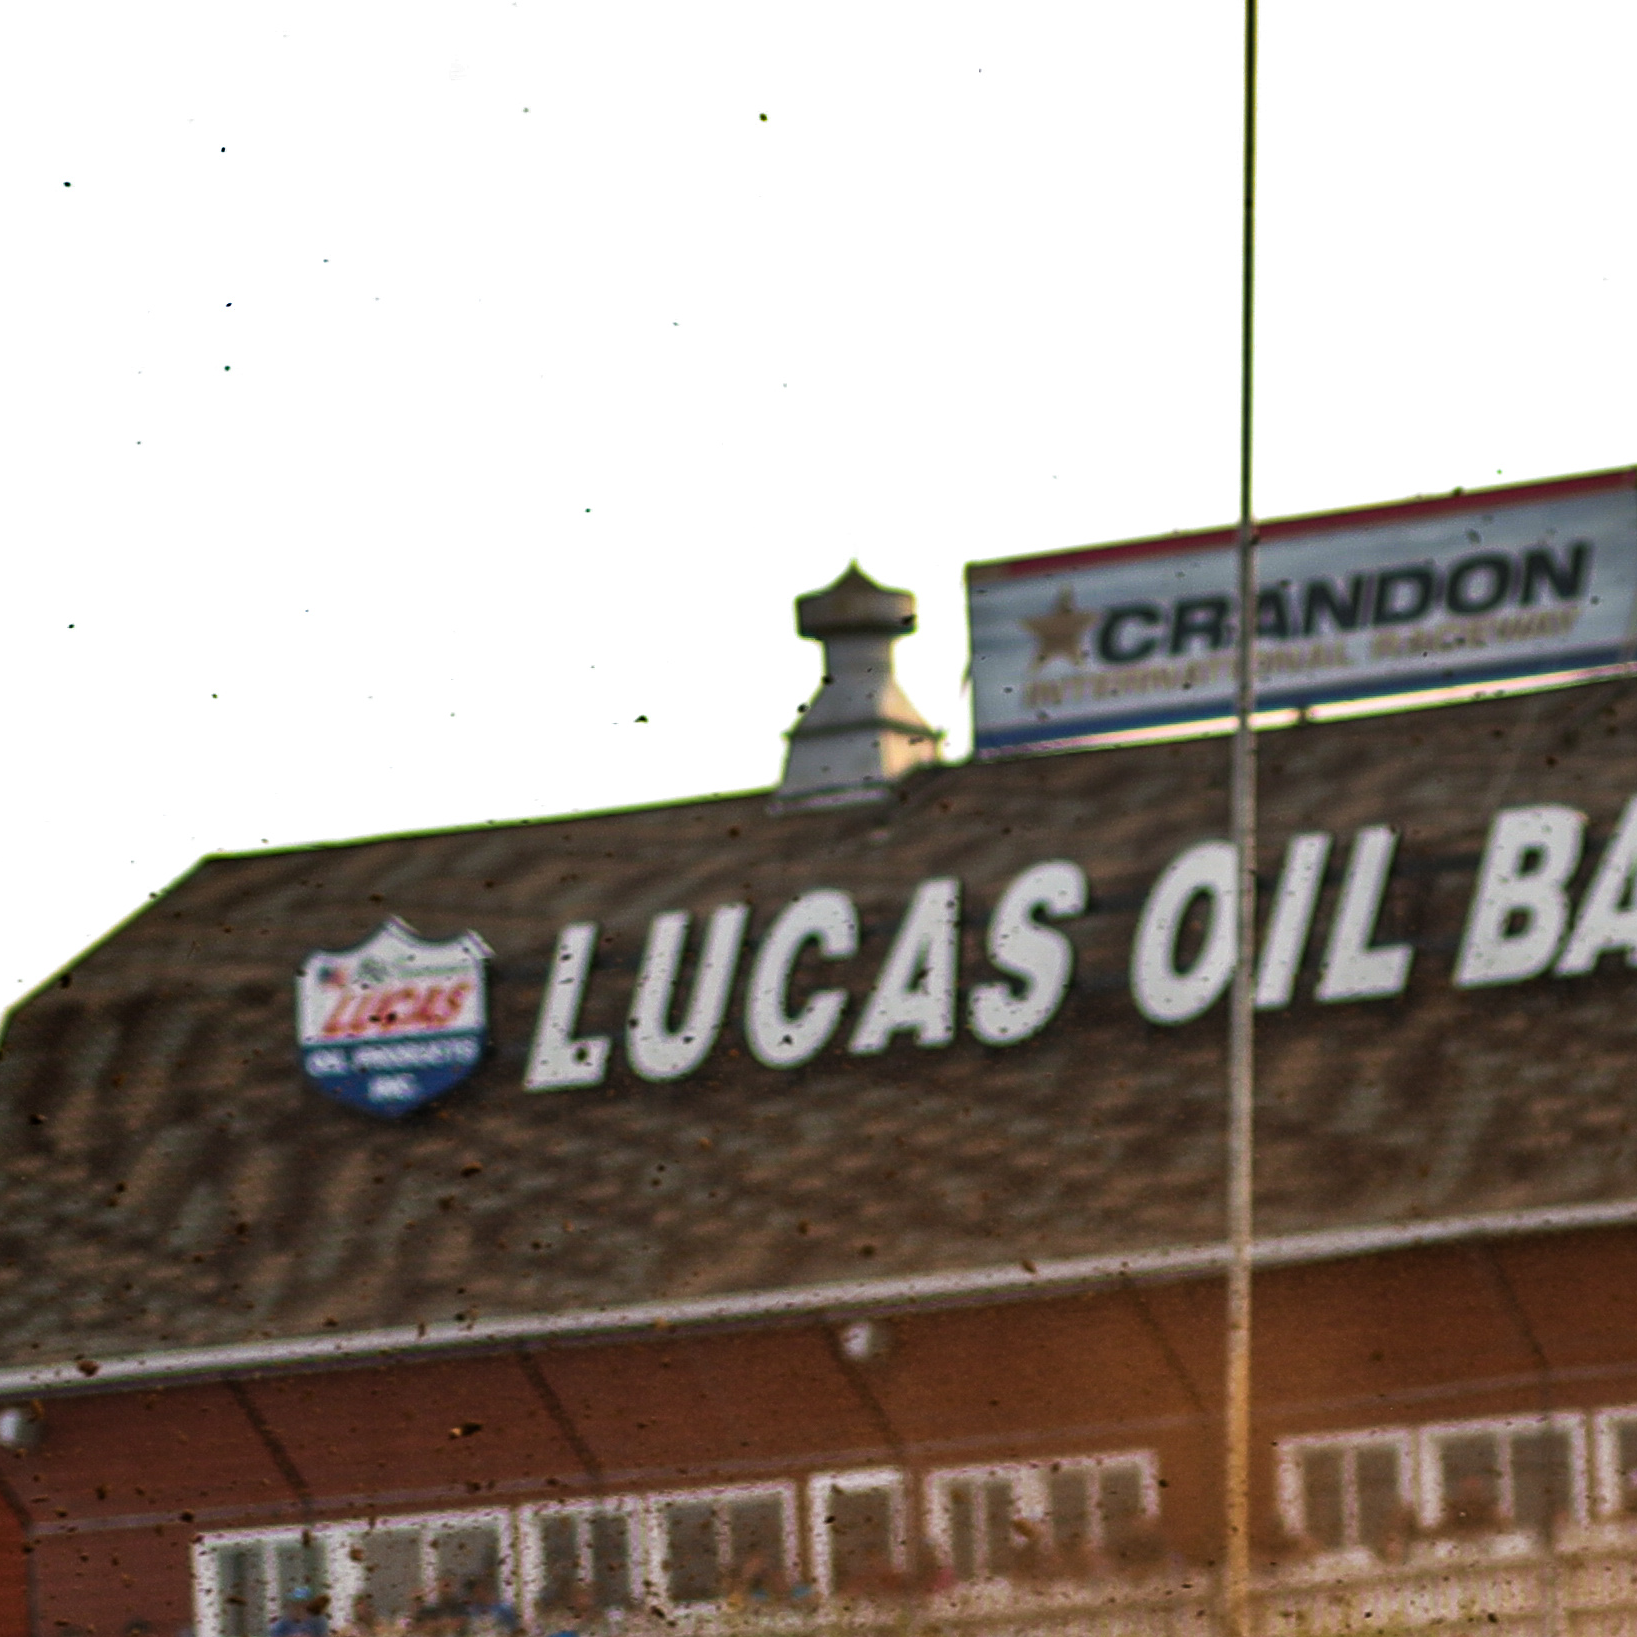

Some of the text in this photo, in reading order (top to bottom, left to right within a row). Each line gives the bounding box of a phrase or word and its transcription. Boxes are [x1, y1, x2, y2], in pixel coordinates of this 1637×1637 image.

[1098, 542, 1591, 664] CRANDON
[521, 859, 1090, 1093] LUCAS
[1129, 824, 1414, 1026] OIL
